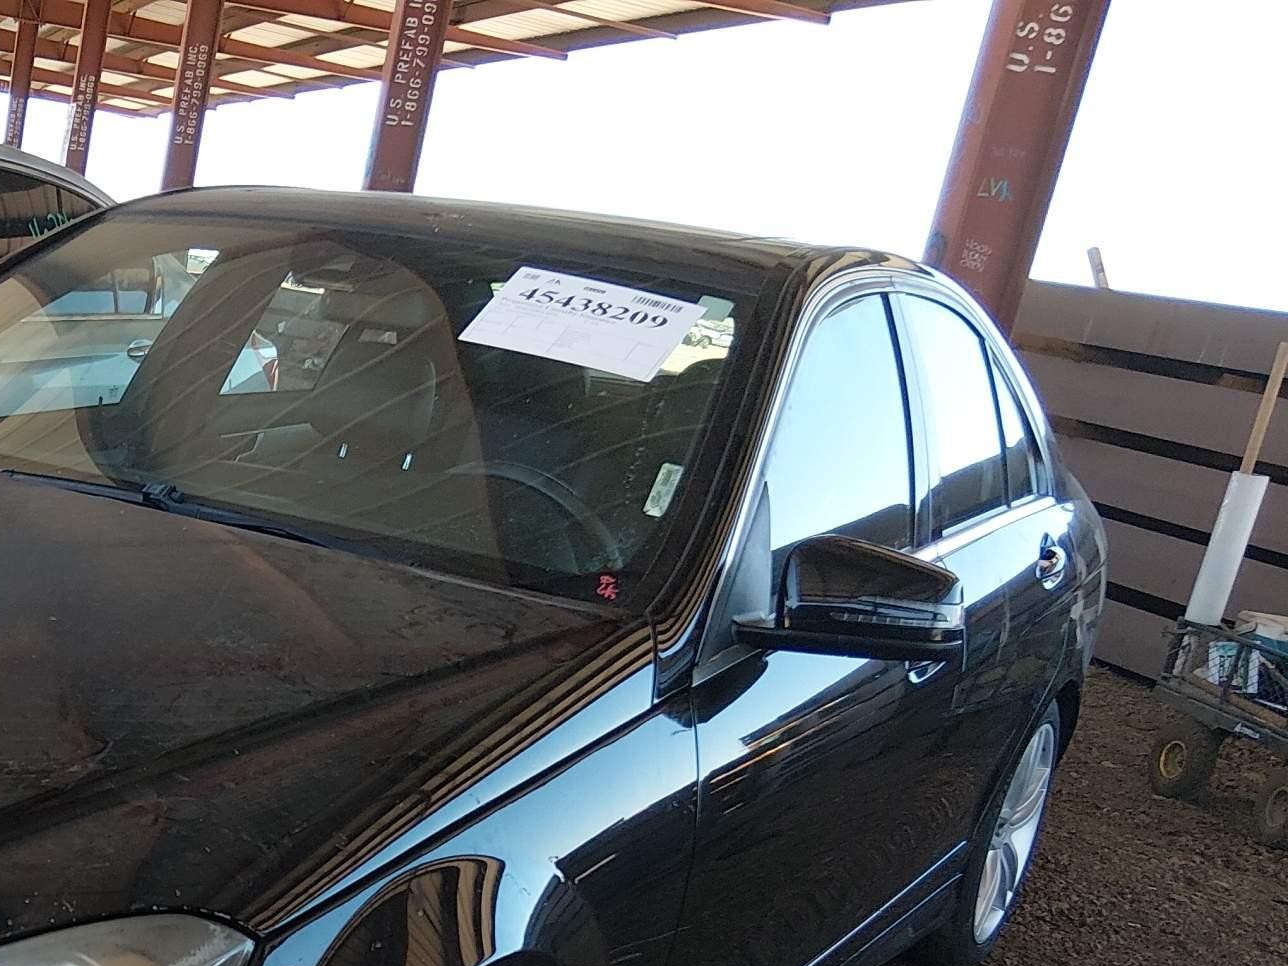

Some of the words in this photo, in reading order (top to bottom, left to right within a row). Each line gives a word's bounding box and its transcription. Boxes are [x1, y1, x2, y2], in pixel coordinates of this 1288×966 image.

[394, 16, 418, 84] PREFAB
[401, 0, 437, 126] 1-866-799-09
[1005, 13, 1044, 72] U.S.
[178, 70, 194, 116] PREFAB
[518, 286, 669, 329] 45438209
